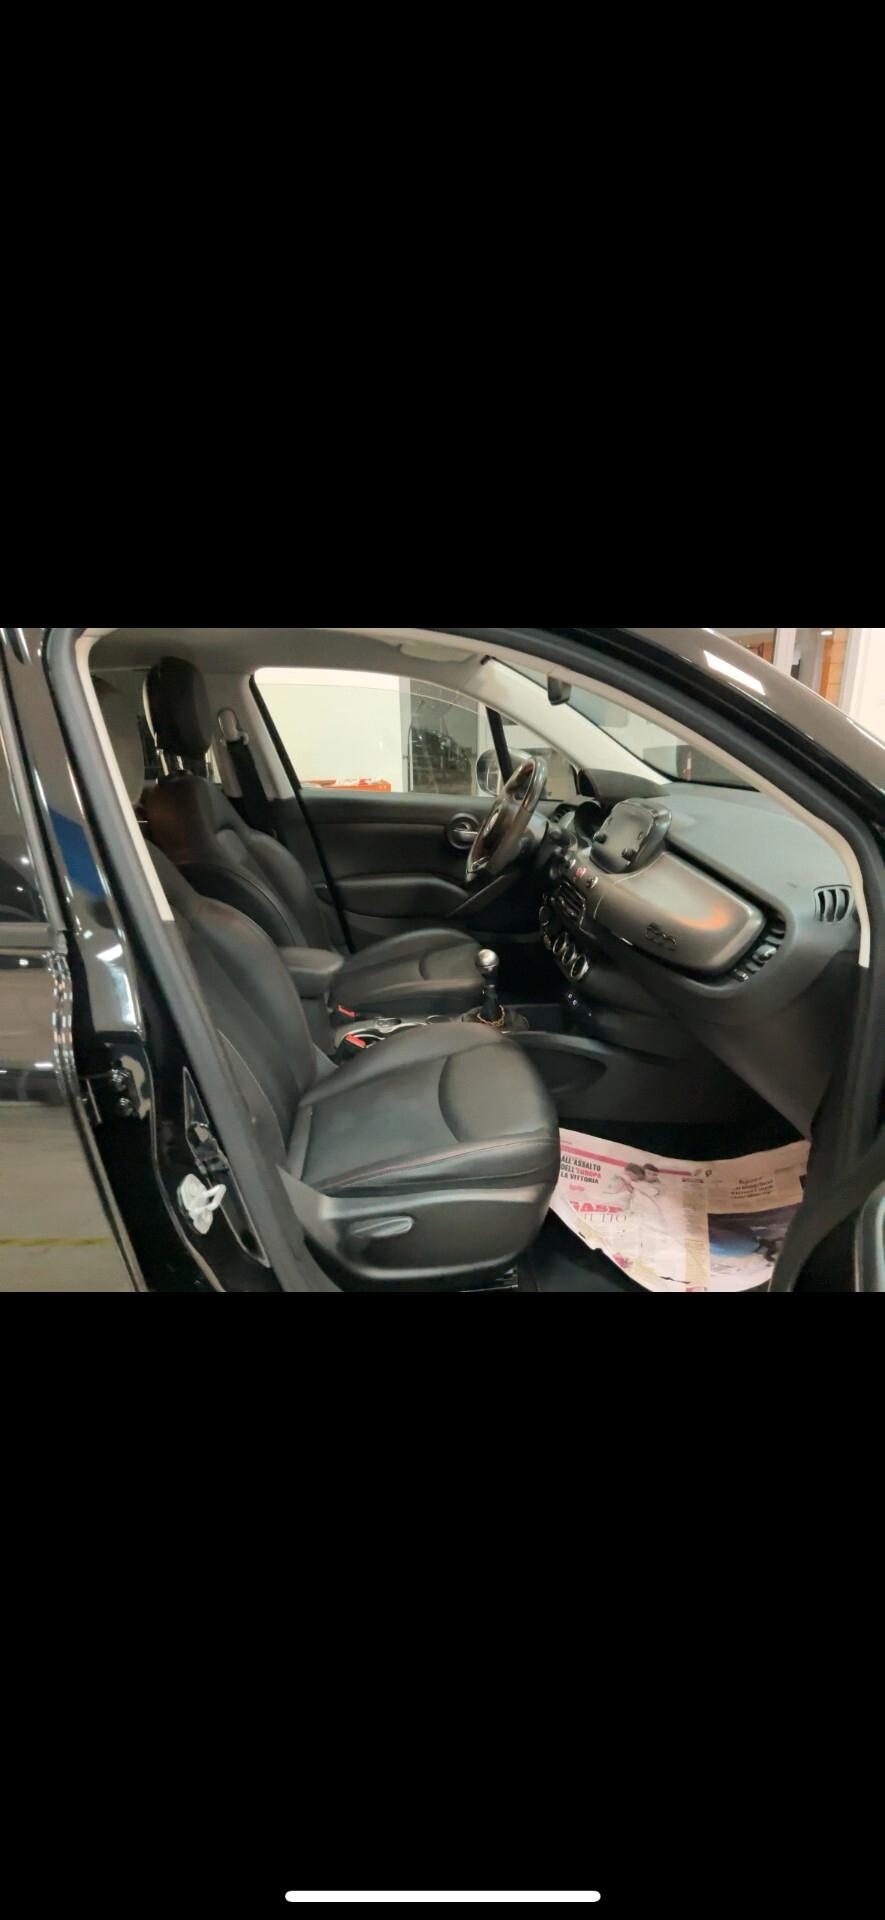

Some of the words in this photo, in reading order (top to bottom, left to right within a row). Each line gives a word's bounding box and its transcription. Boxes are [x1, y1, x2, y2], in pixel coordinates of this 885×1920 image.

[560, 1155, 601, 1172] ALL'ASSALTO
[560, 1171, 569, 1179] LA
[570, 1173, 599, 1184] VITTORIA
